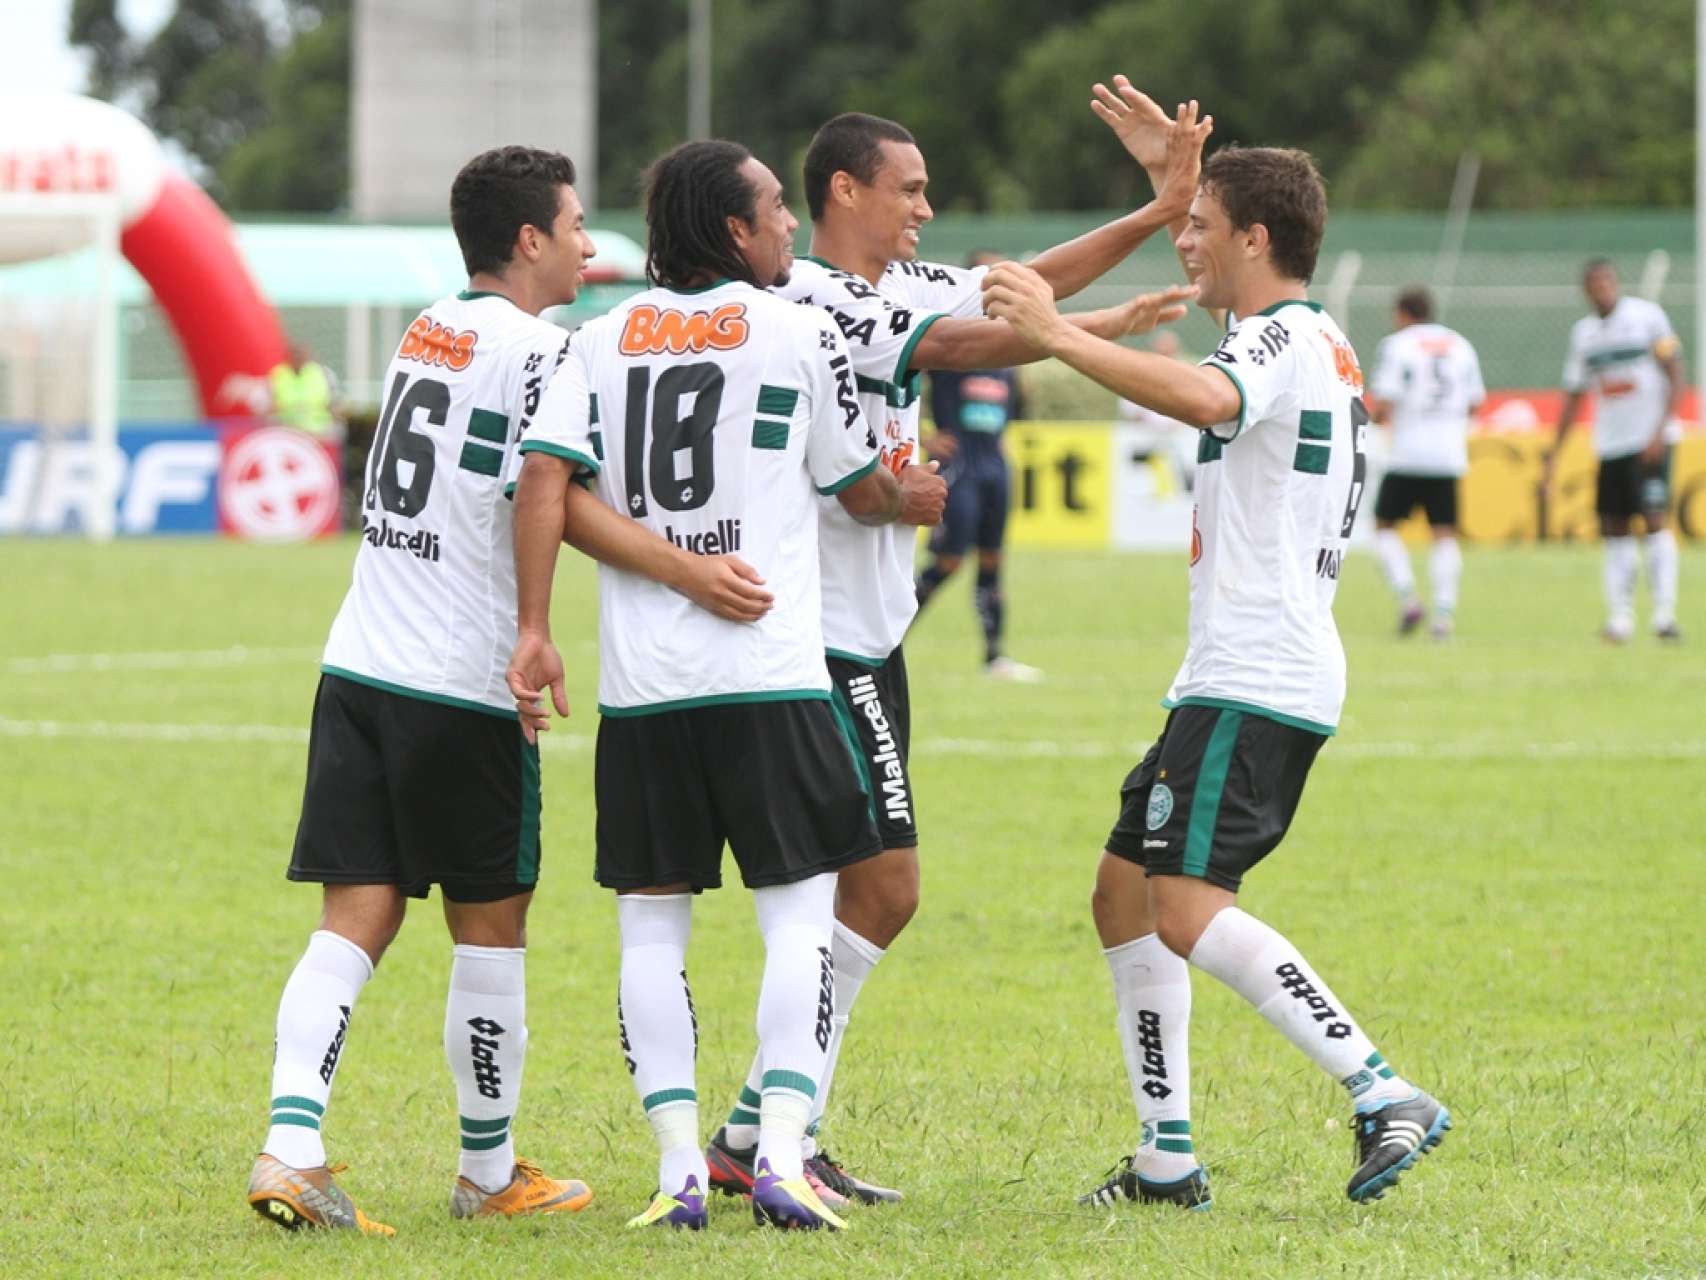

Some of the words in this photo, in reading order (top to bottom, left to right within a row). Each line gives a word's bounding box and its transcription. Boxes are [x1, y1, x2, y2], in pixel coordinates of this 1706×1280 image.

[398, 314, 479, 372] BMG
[618, 302, 750, 357] BMG
[824, 304, 878, 347] RA
[829, 353, 861, 430] IRA
[366, 370, 451, 520] 16
[624, 361, 726, 519] 18
[847, 673, 912, 825] JMalucelli
